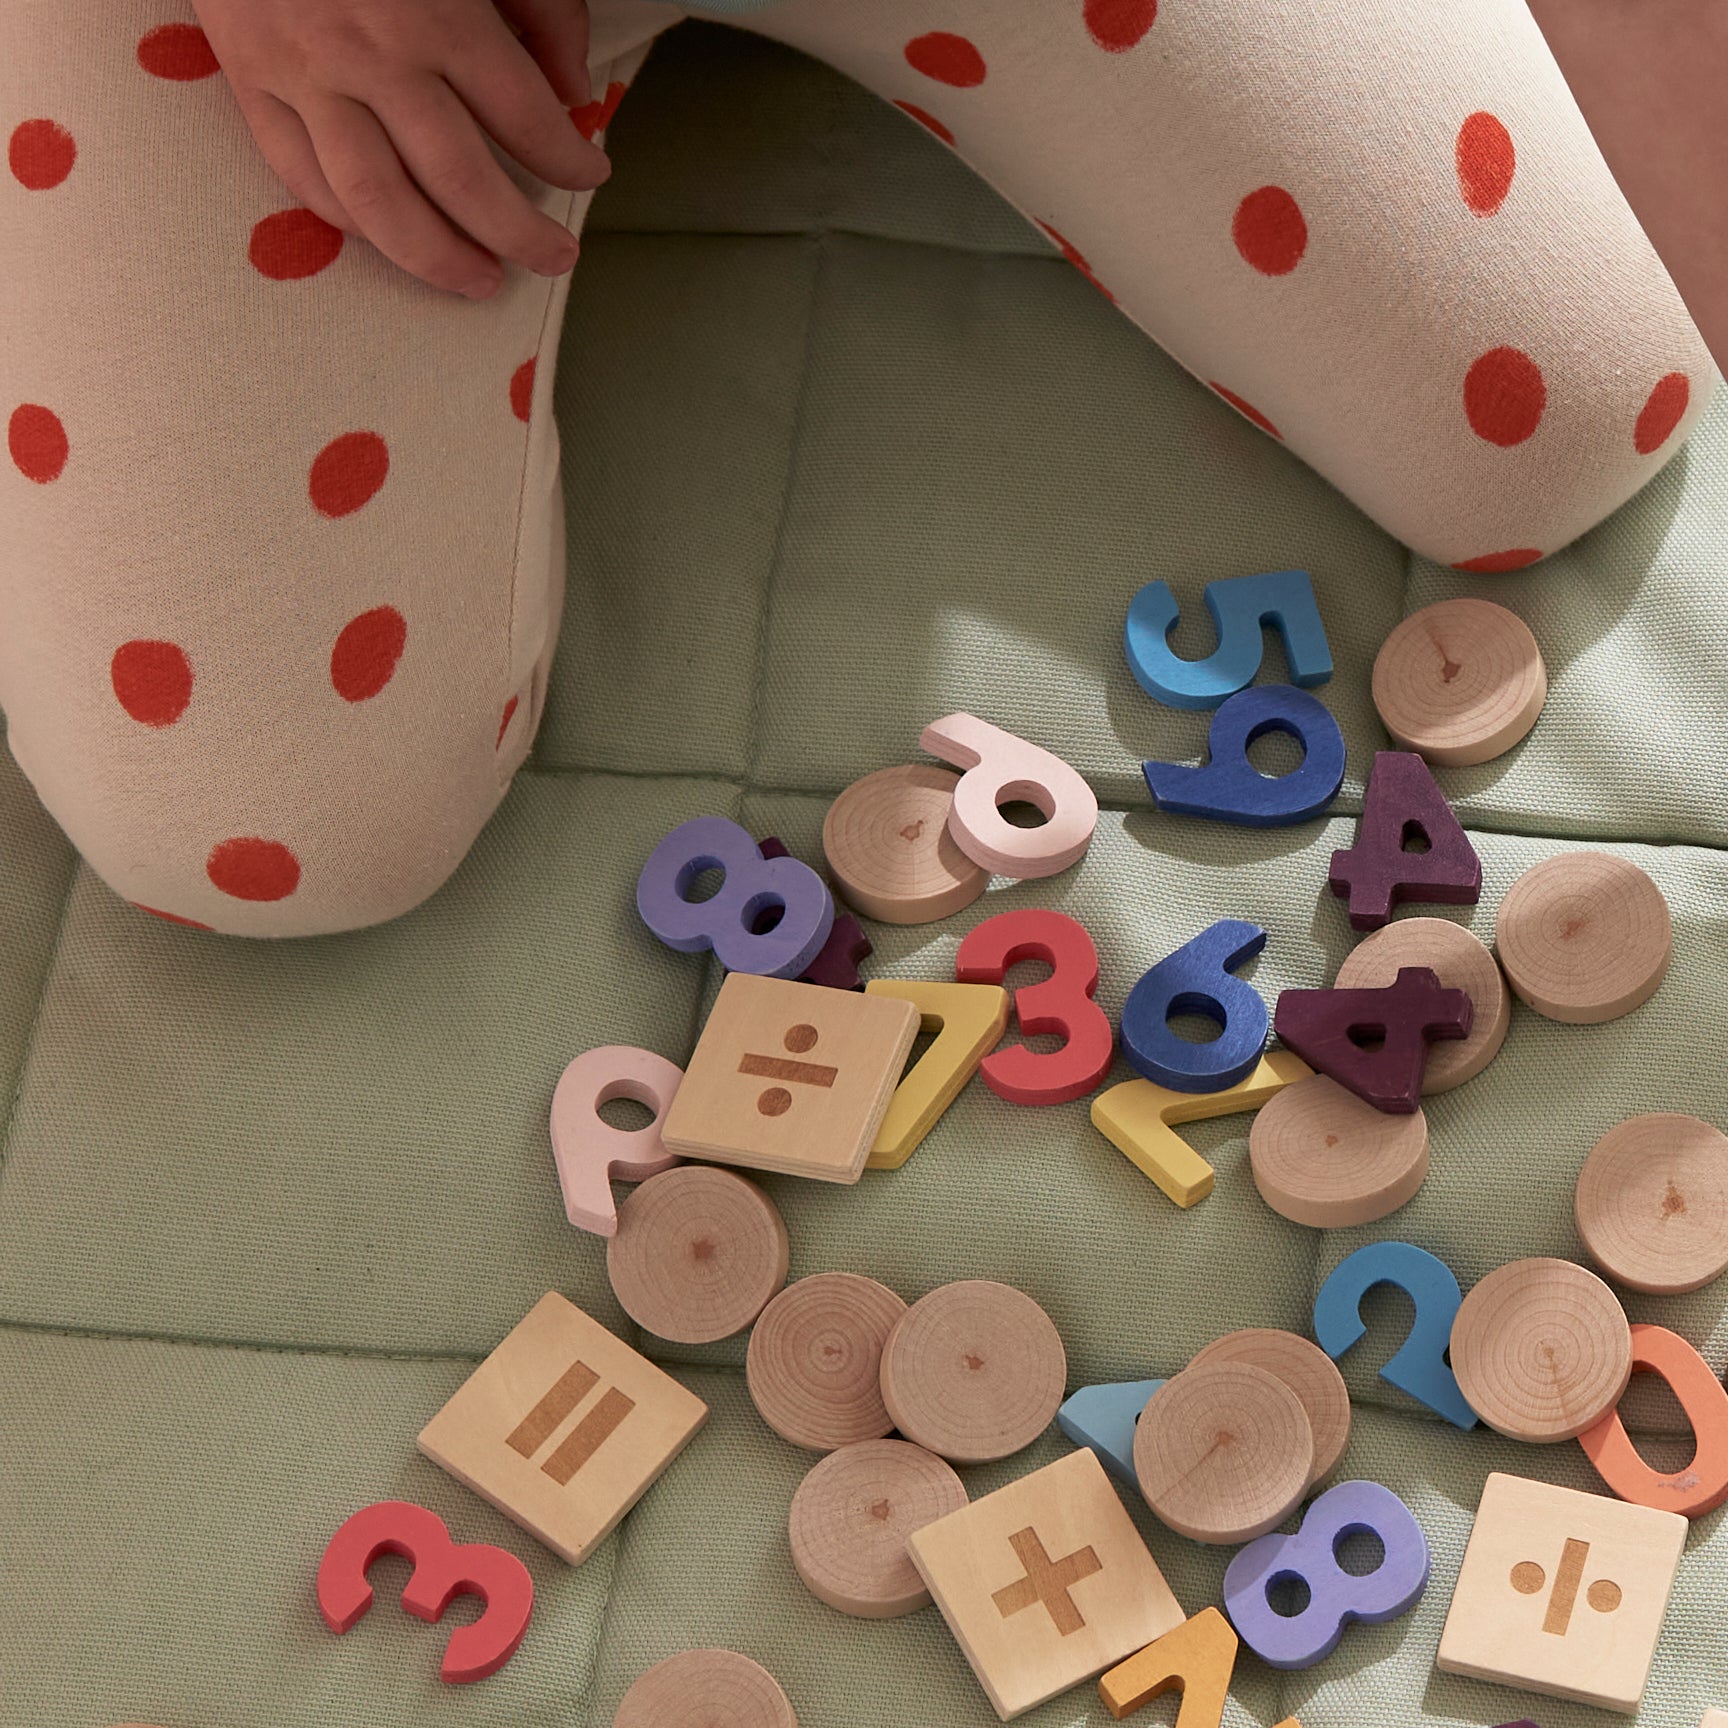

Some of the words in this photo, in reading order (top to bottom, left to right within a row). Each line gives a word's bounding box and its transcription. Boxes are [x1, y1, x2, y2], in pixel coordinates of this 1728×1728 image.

[1125, 569, 1334, 710] 5
[637, 816, 834, 976] 8
[956, 909, 1112, 1106] 3
[1121, 919, 1267, 1093] 6
[1274, 967, 1473, 1114] 4
[317, 1501, 533, 1684] 3
[1224, 1480, 1430, 1670] 8
